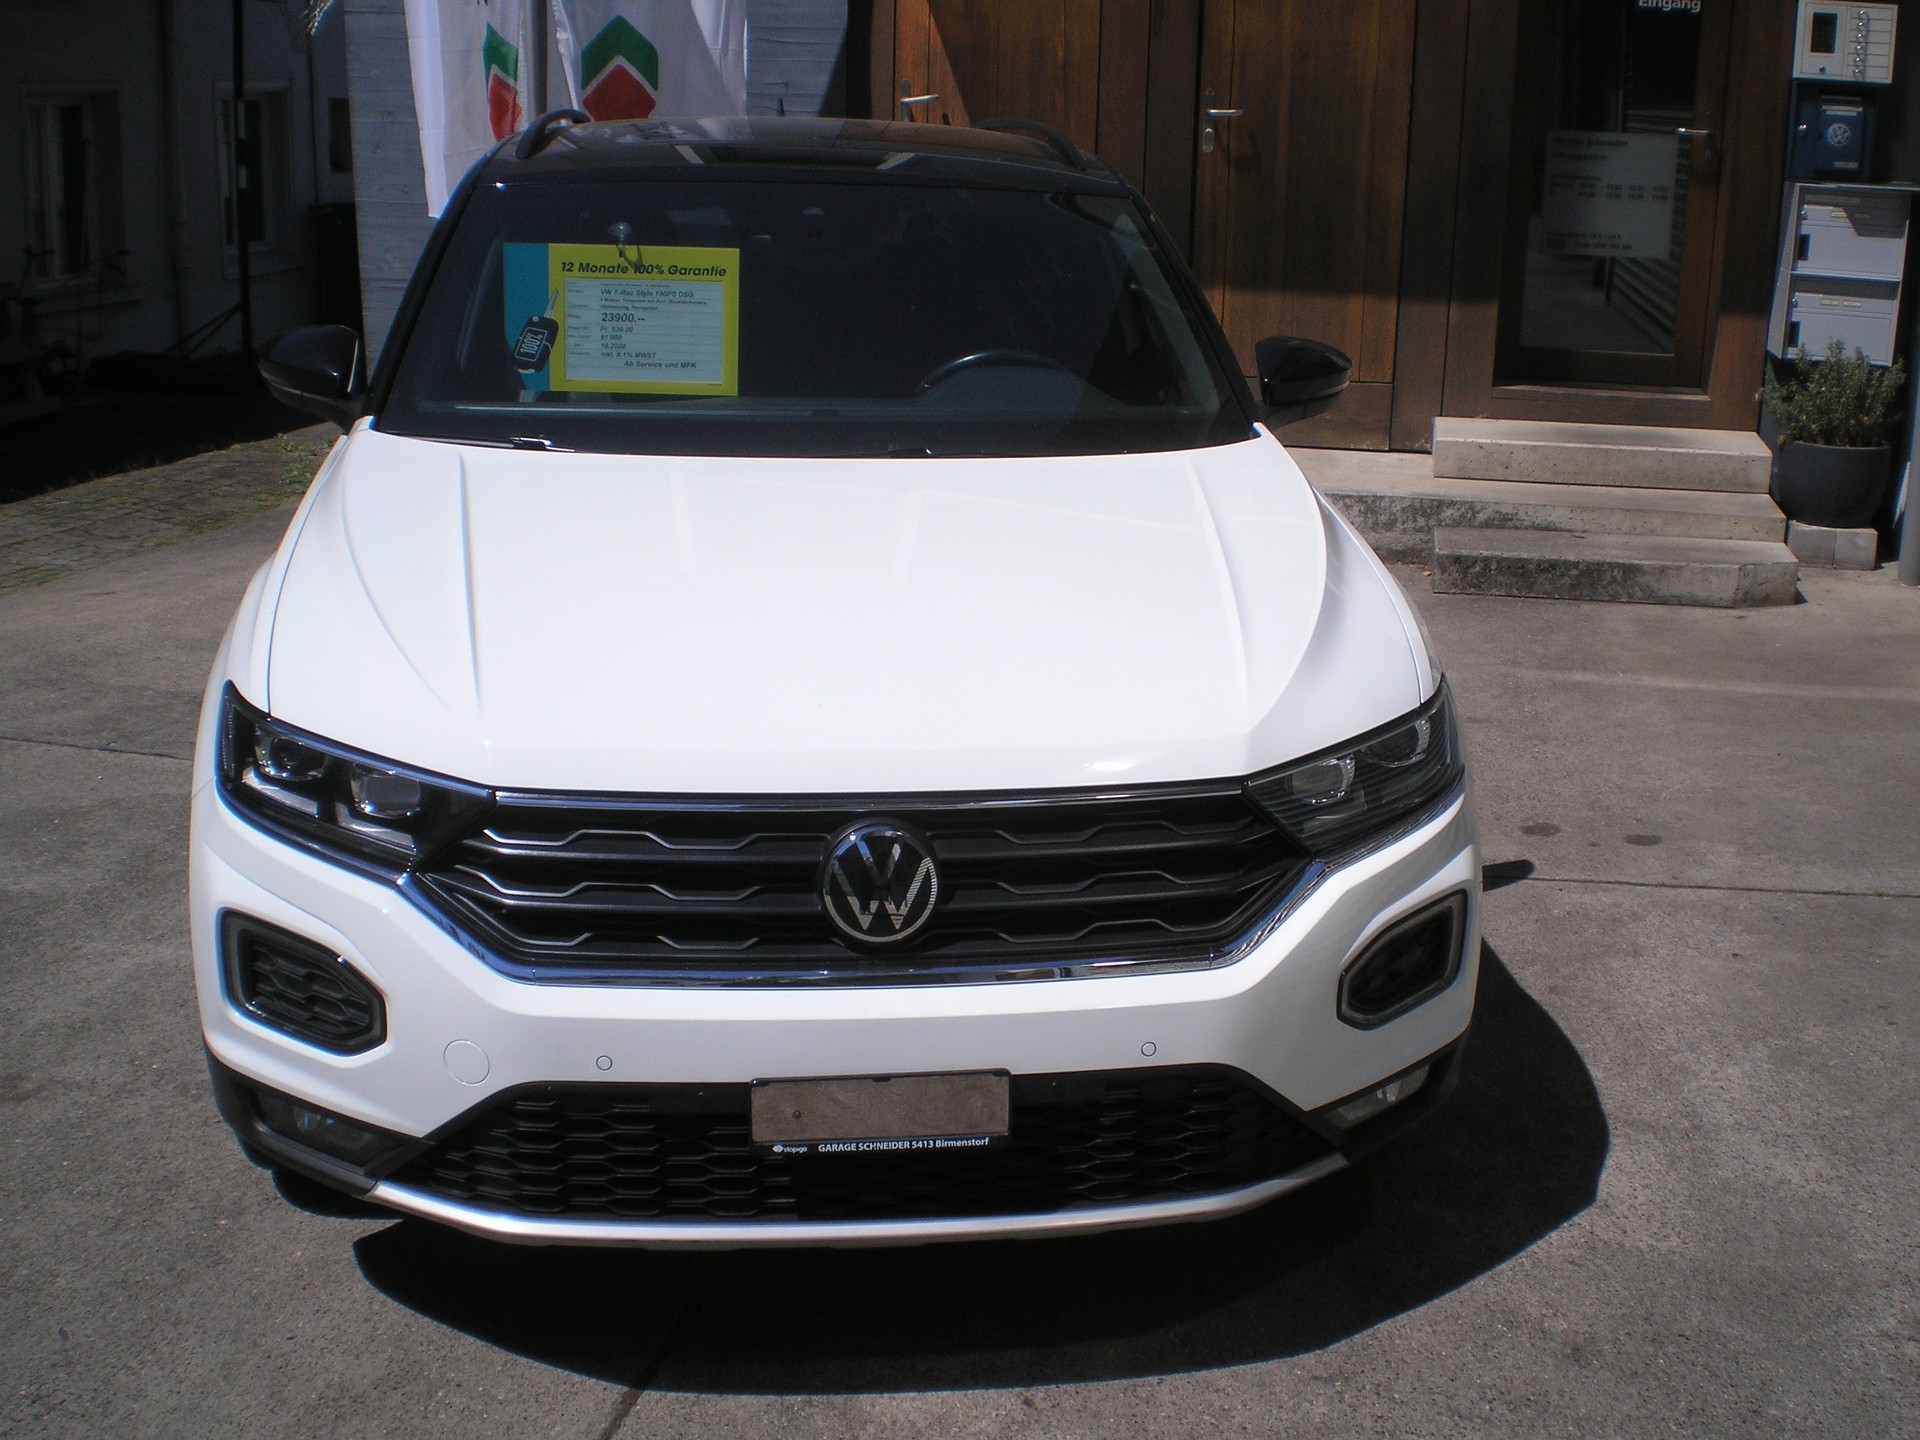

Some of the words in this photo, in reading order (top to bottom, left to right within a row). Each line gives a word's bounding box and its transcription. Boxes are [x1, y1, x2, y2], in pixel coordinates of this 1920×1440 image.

[561, 262, 575, 272] 12
[578, 262, 629, 274] Monate
[634, 264, 665, 275] 100%
[668, 265, 727, 277] Garantie
[636, 289, 653, 298] Style
[520, 332, 543, 354] 100%
[817, 1141, 857, 1152] GARAGE
[858, 1140, 910, 1151] SCHNEIDER
[911, 1139, 934, 1149] 5413
[935, 1137, 990, 1148] Birmenstorf
